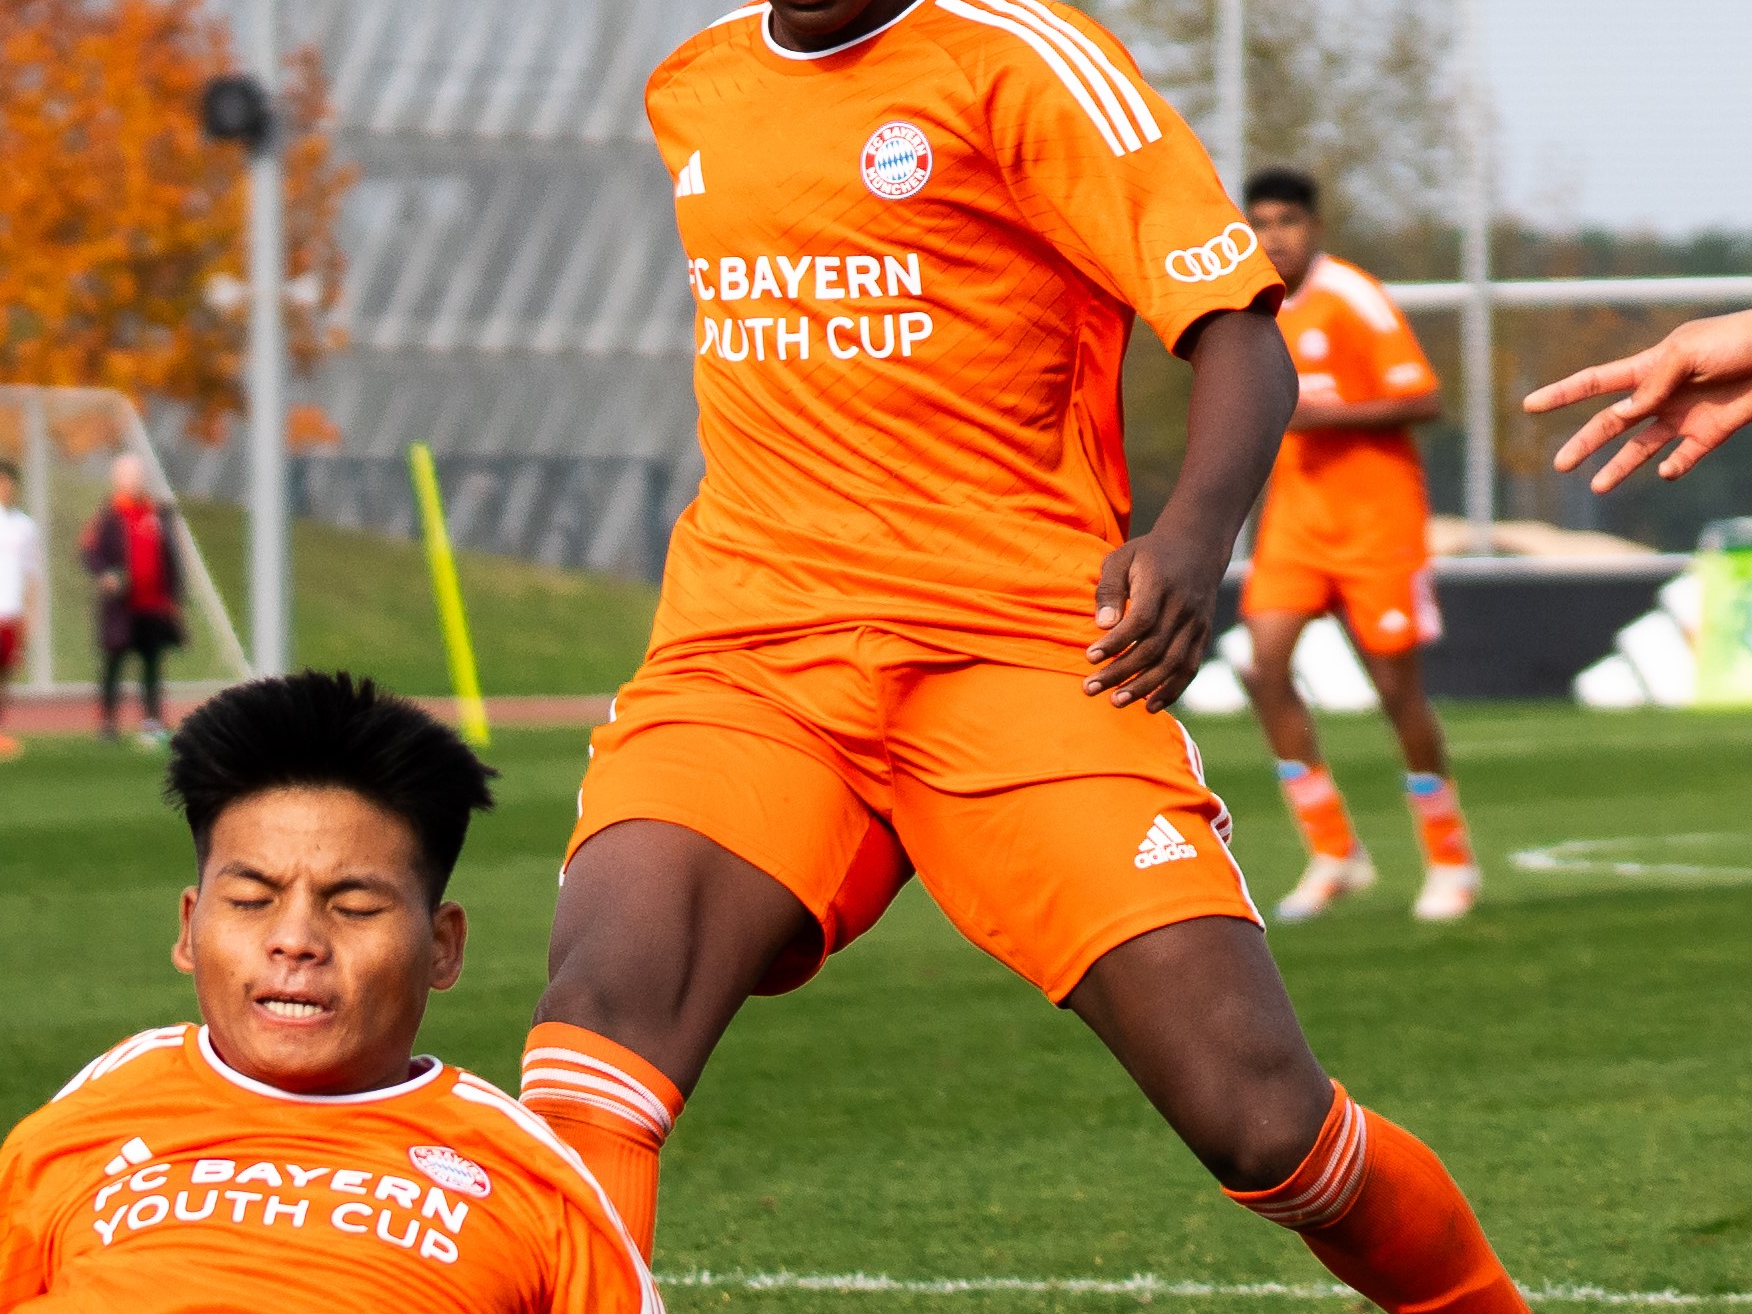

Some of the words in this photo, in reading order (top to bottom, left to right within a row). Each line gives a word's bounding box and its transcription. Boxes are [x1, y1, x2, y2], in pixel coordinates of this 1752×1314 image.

[719, 253, 923, 301] BAYERN
[826, 311, 934, 360] CUP
[1134, 842, 1198, 869] adidas
[94, 1163, 171, 1213] FC
[190, 1158, 469, 1234] BAYERN
[93, 1188, 310, 1246] YOUTH
[330, 1201, 460, 1264] CUP
